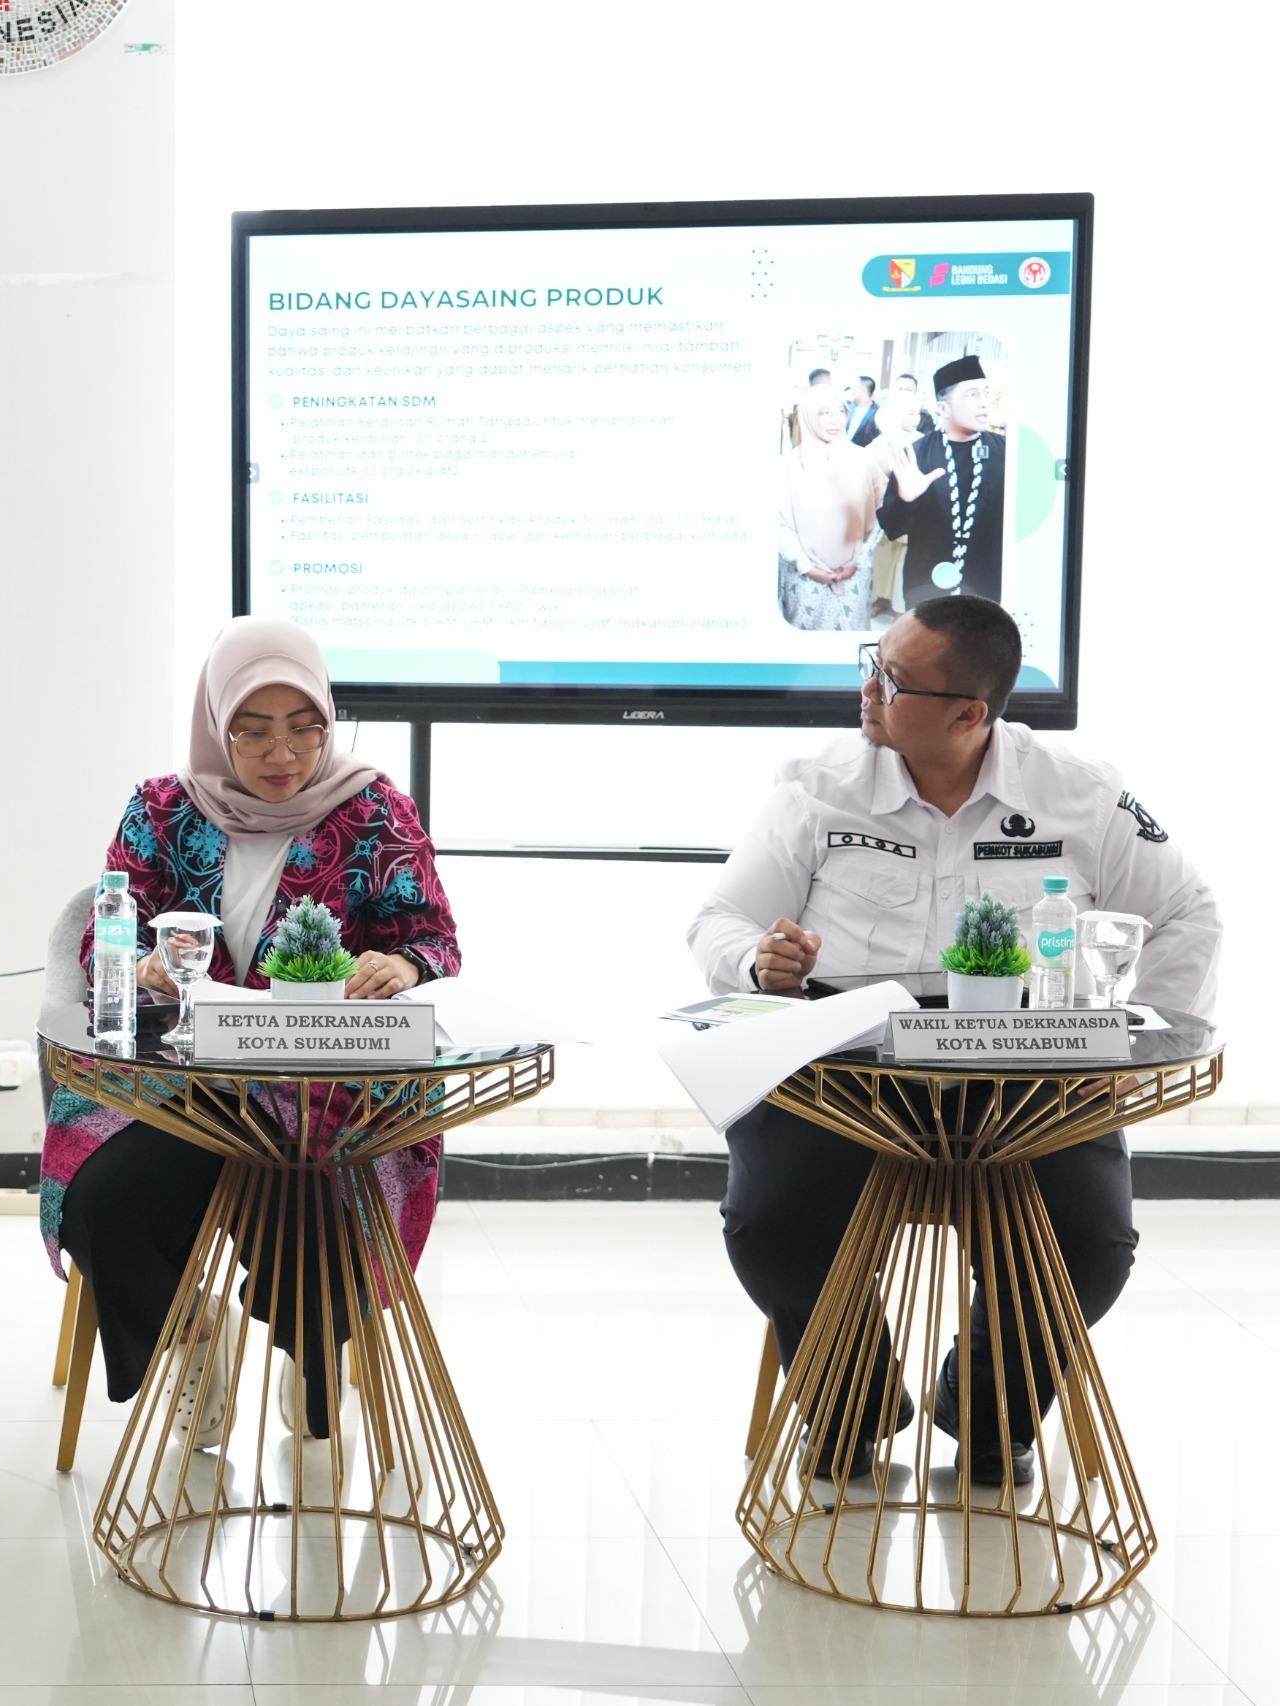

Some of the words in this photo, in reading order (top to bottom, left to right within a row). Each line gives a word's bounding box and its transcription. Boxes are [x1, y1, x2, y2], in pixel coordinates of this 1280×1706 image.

[951, 264, 994, 275] BANDUNG
[951, 275, 976, 285] LEBIH
[268, 291, 371, 311] BIDANG
[380, 288, 537, 310] DAYASAING
[546, 286, 664, 307] PRODUK
[292, 395, 398, 408] PENINGKATAN
[401, 395, 437, 407] SDM
[292, 492, 369, 505] FASILITASI
[293, 562, 364, 575] PROMOSI
[977, 845, 1013, 856] PEMKOT
[217, 1014, 280, 1027] KETUA
[285, 1015, 411, 1028] DEKRANASDA
[899, 1018, 950, 1030] WAKIL
[954, 1018, 1008, 1030] KETUA
[1012, 1017, 1120, 1029] DEKRANASDA
[237, 1036, 289, 1049] KOTA
[294, 1037, 391, 1050] SUKABUMI
[936, 1038, 987, 1050] KOTA
[992, 1037, 1088, 1050] SUKABUMI
